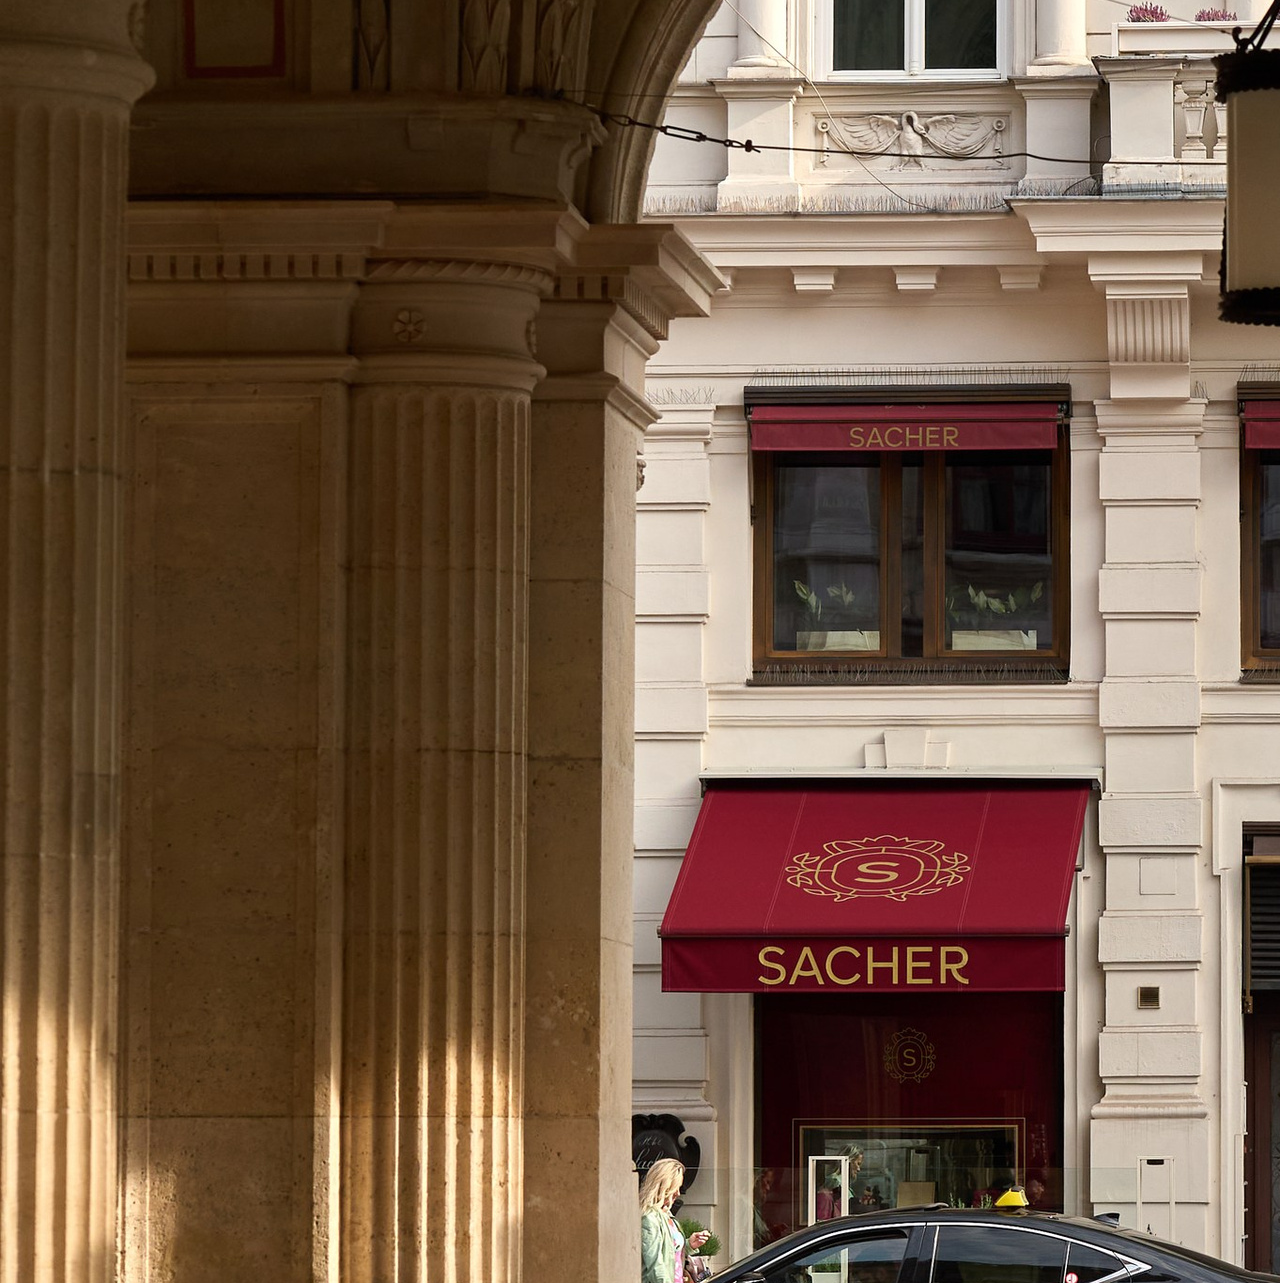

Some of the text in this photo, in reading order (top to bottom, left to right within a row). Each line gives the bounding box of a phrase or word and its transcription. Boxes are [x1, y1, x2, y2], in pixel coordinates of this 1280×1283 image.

[849, 426, 959, 448] SACHER
[854, 861, 900, 883] S
[758, 946, 970, 985] SACHER
[903, 1048, 917, 1067] S
